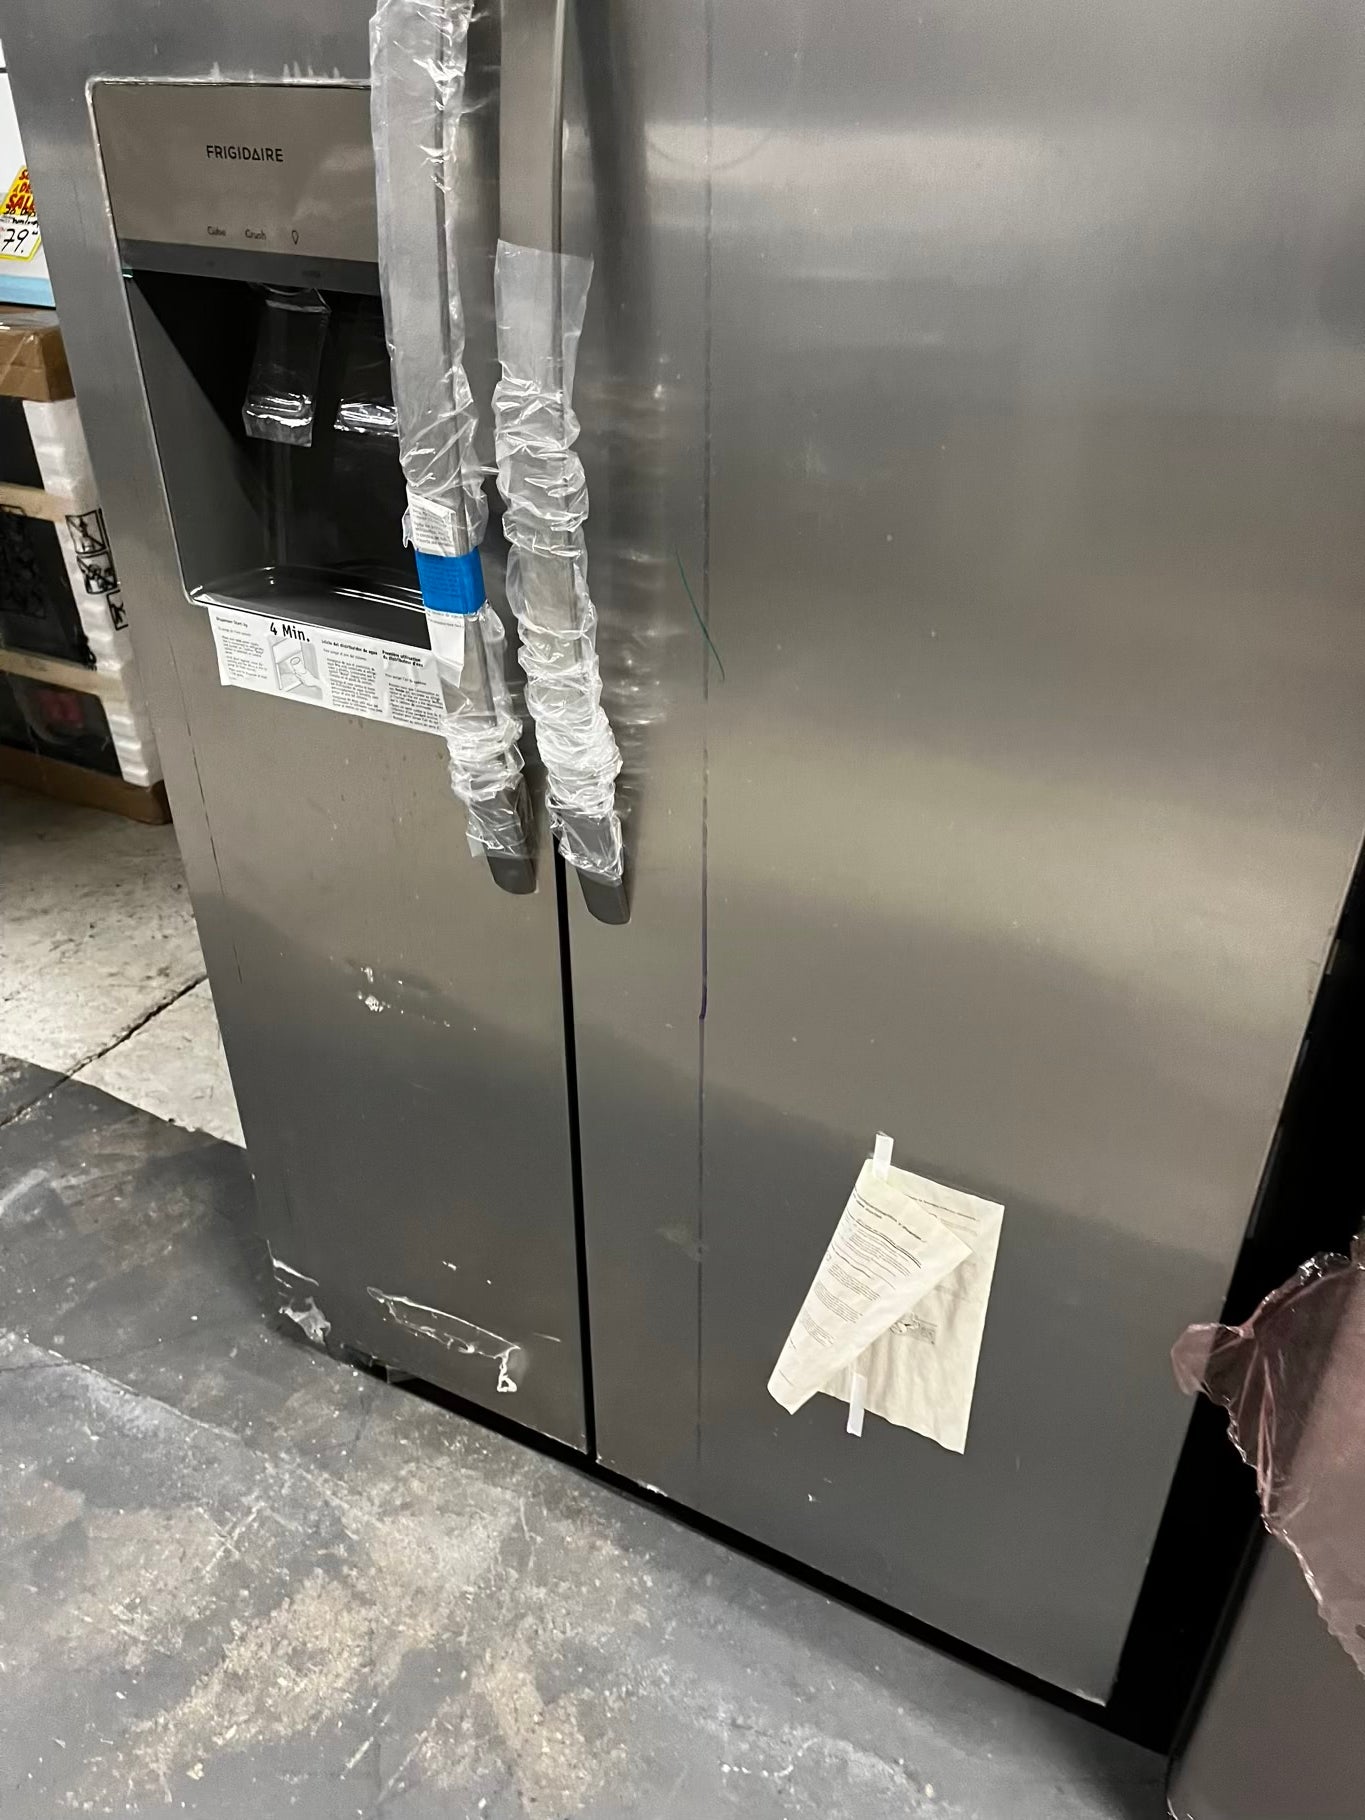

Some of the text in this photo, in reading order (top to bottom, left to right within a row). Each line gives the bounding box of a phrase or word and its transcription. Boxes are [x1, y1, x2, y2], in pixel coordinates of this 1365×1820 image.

[206, 144, 284, 162] FRIGIDAIRE
[270, 622, 277, 636] 4
[282, 623, 310, 642] Min.
